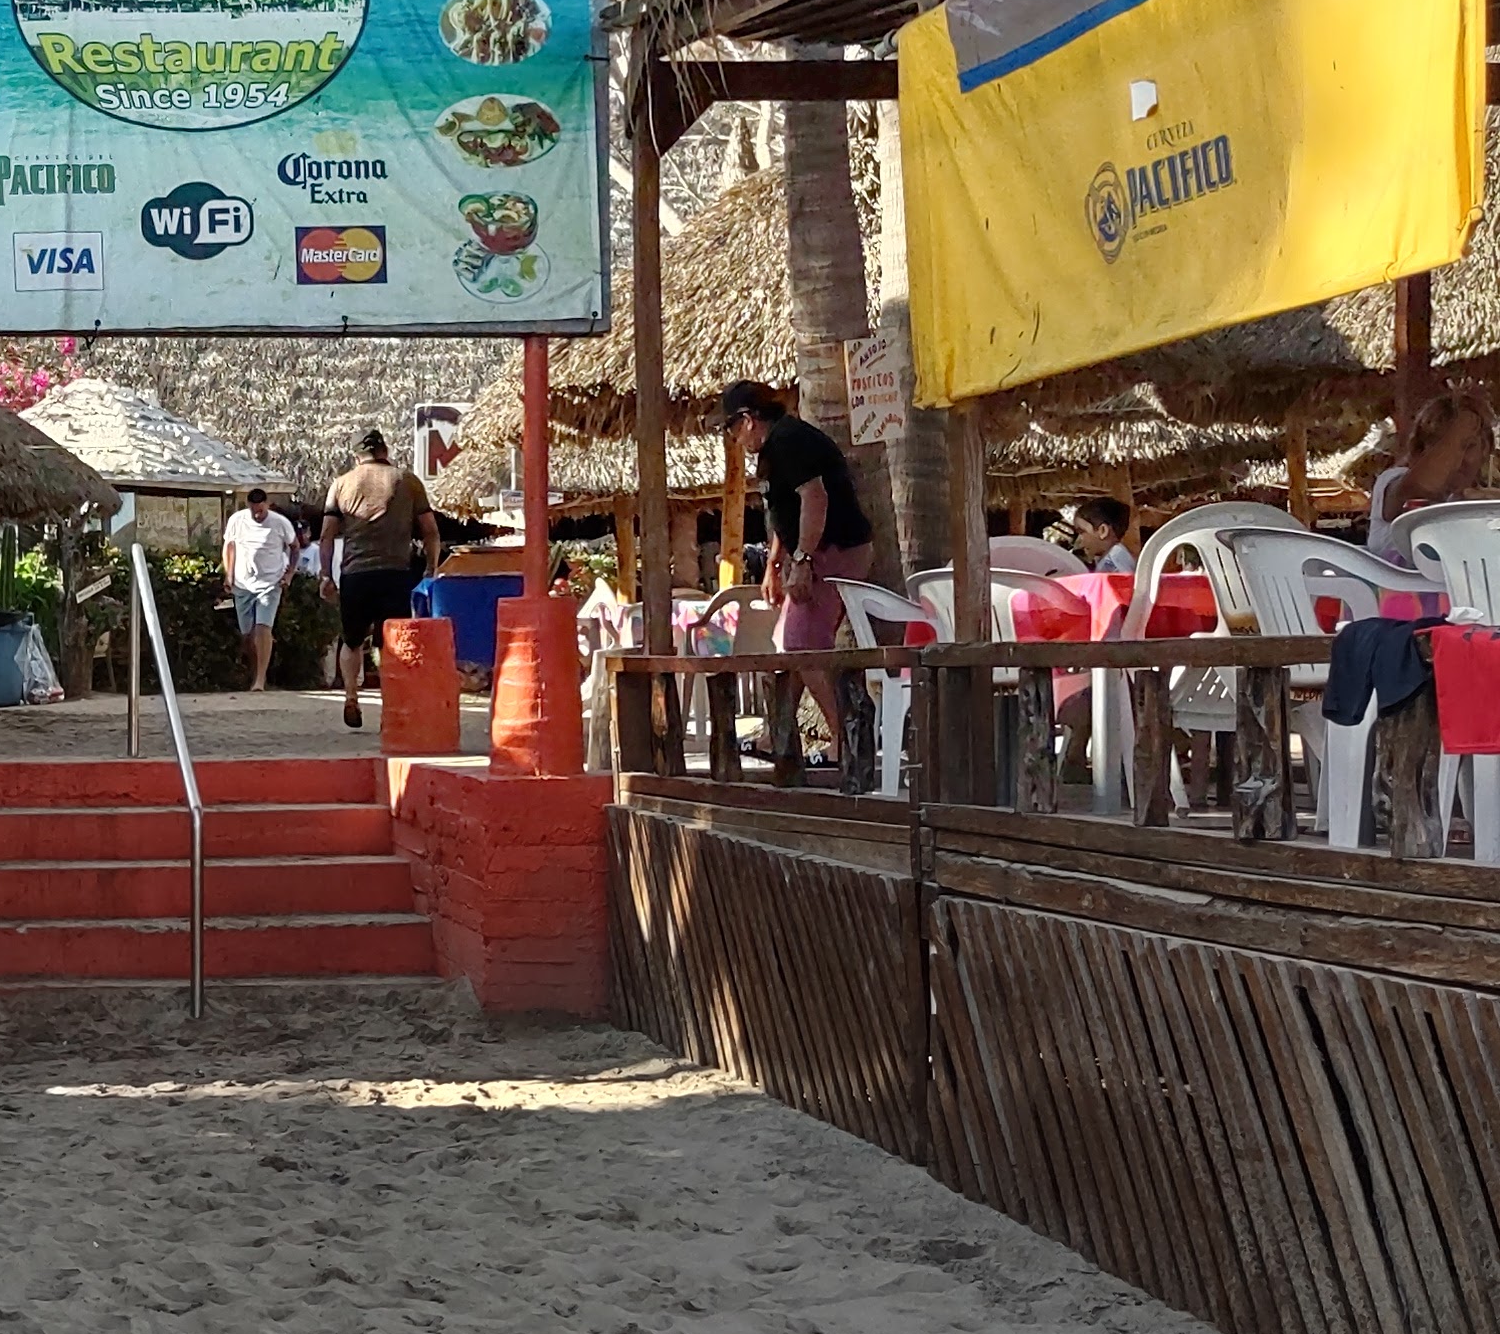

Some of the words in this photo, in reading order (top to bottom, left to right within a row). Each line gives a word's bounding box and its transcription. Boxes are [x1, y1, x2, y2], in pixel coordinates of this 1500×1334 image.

[36, 31, 345, 75] Restaurant
[94, 82, 192, 110] Since
[202, 82, 290, 110] 1954
[277, 152, 389, 189] Corona
[1125, 134, 1235, 230] PACIFICO
[310, 182, 368, 205] Extra
[21, 247, 96, 275] VISA
[301, 247, 380, 264] MasterCard
